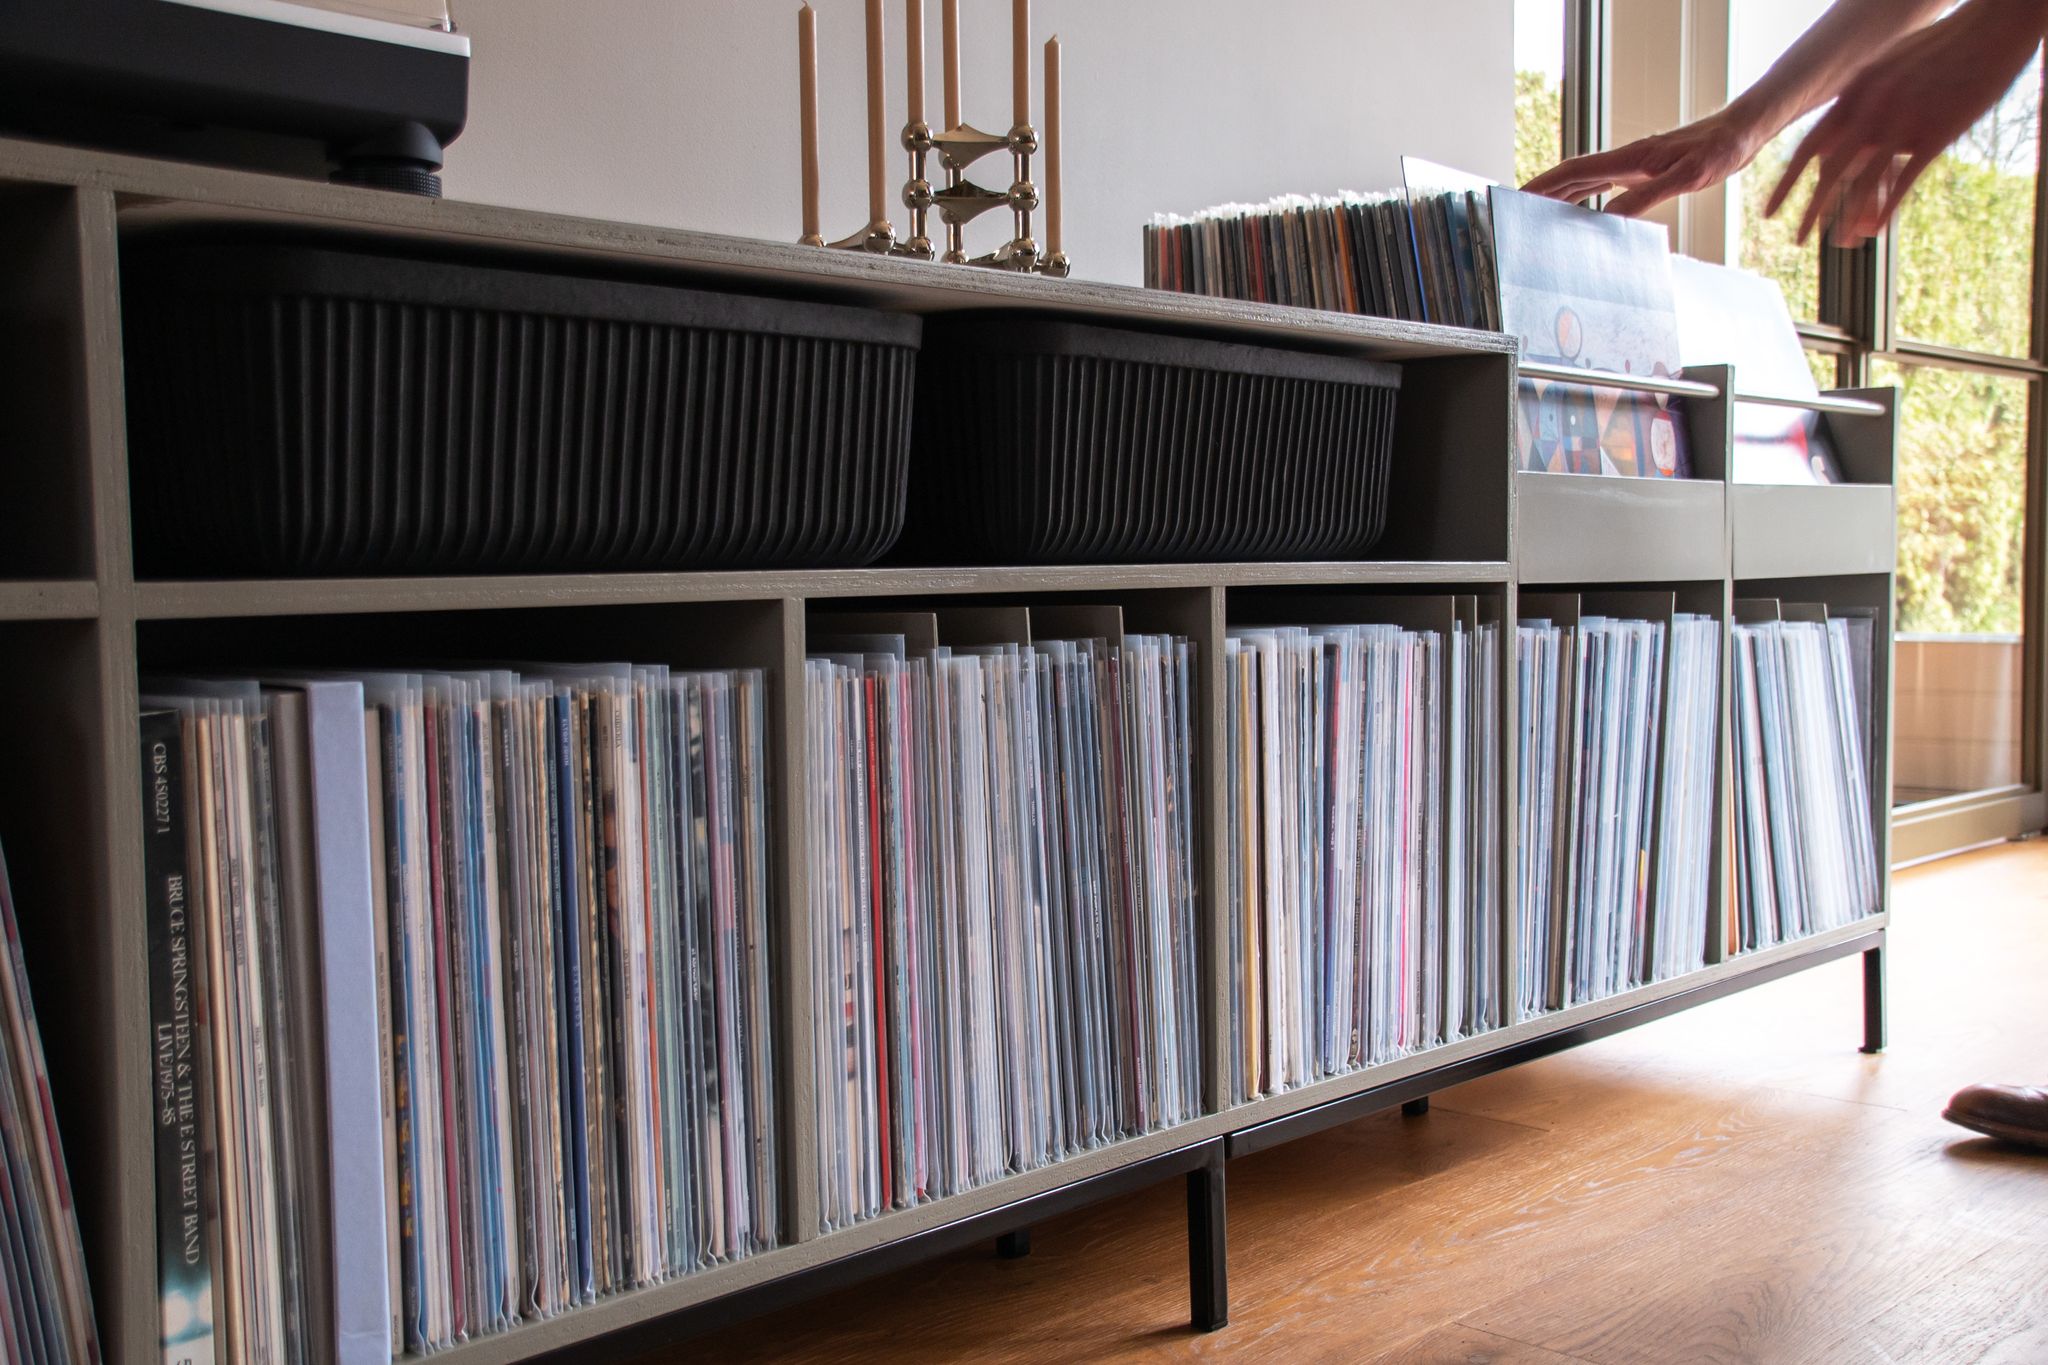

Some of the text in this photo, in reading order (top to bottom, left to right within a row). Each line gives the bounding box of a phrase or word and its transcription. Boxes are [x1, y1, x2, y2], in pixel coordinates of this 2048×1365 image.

[562, 718, 570, 743] ELTON
[152, 743, 168, 775] CBS
[155, 776, 169, 822] 450227
[168, 874, 199, 1265] BRUCE SPRINGSTEEN & THE E STREET BAND
